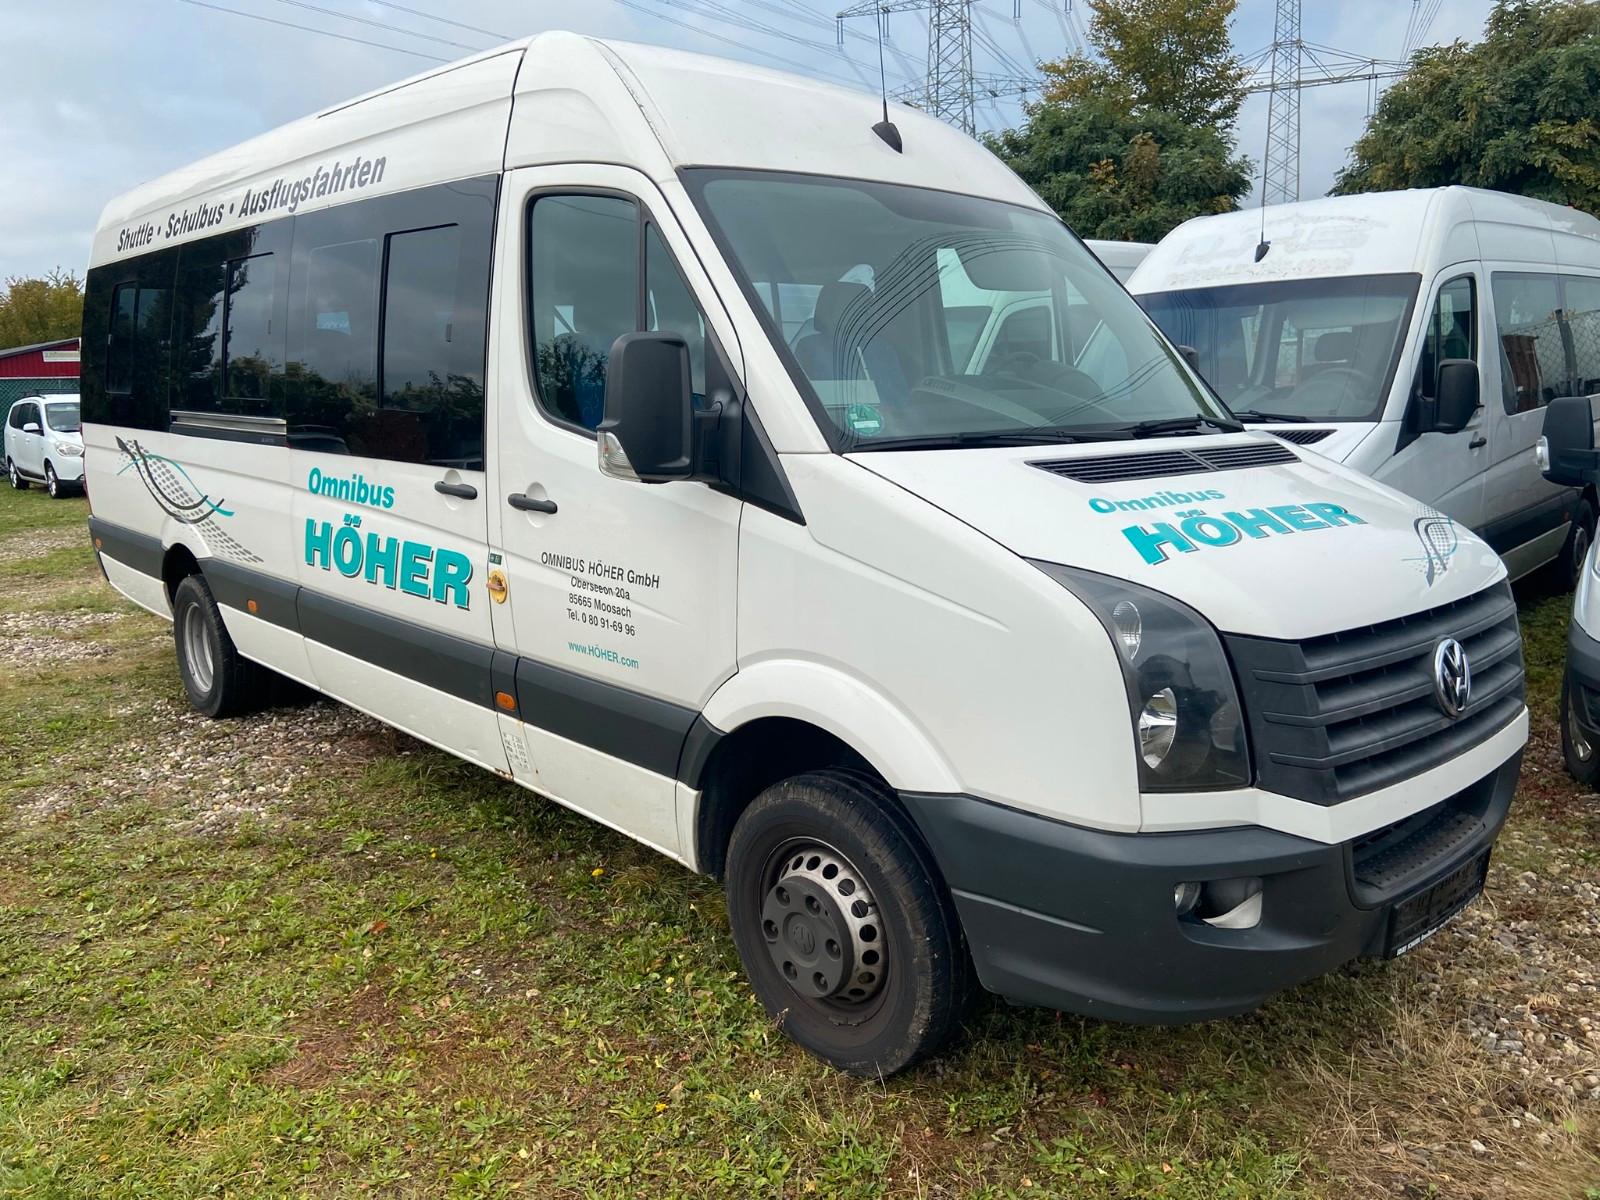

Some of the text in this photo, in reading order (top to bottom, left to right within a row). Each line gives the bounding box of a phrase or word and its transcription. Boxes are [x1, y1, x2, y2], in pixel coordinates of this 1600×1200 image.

[117, 156, 387, 252] Shuttle Schulbus Ausflugsfahrten
[309, 467, 394, 509] Omnibus
[1088, 486, 1226, 514] Omnibus
[1121, 501, 1369, 565] HÖHER
[304, 513, 474, 611] HÖHER
[541, 551, 660, 589] OMNIBUS HÖHER GmbH
[570, 576, 631, 600] Oberseeon 20a
[568, 593, 632, 618] 85665 Moosach
[566, 608, 636, 637] Tel. 0 80 91-69 96
[567, 641, 640, 669] www.HÖHER.com
